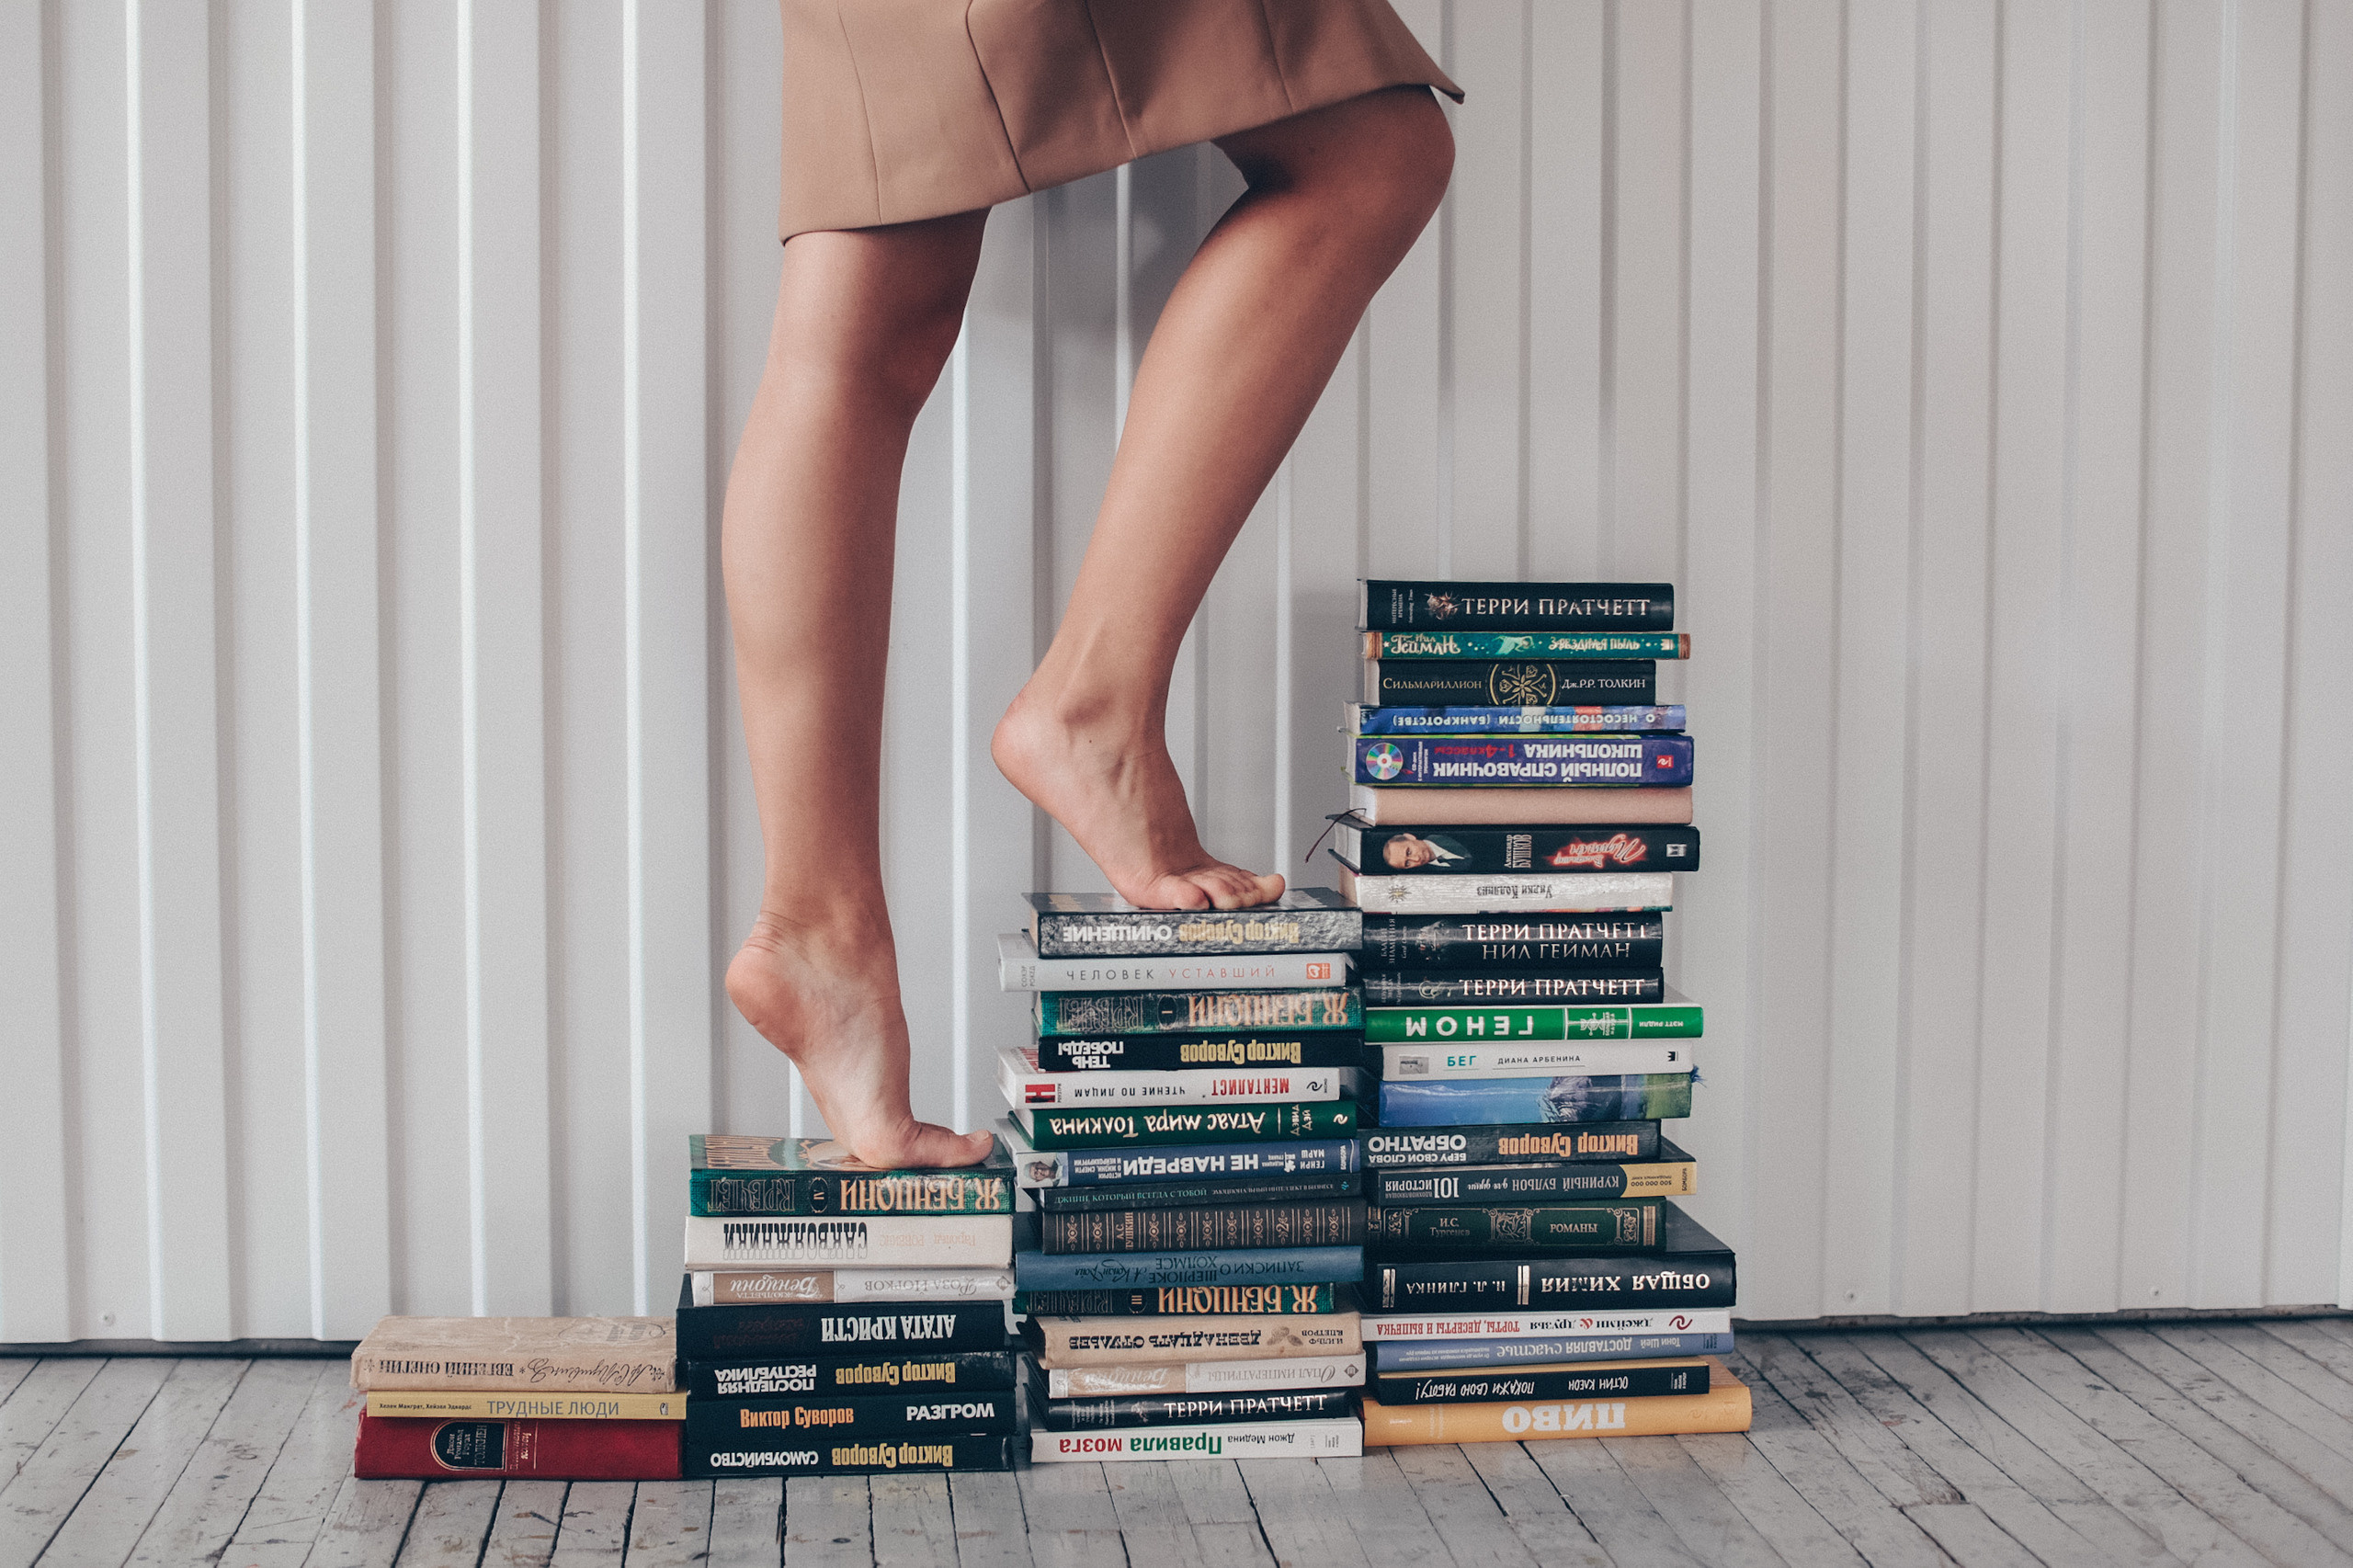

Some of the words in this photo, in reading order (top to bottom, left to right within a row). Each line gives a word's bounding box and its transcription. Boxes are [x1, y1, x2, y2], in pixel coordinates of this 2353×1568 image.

[1461, 597, 1529, 617] ТЕРРИ
[1539, 598, 1651, 617] ПРАТЧЕТТ
[1597, 677, 1646, 689] ТОЛКИН
[1392, 713, 1491, 727] (БАНКРОТСТВЕ)
[1499, 713, 1638, 725] НЕСОСТОЯТЕЛЬНОСТИ
[1645, 713, 1655, 724] О
[1525, 743, 1643, 758] ШКОЛЬНИКА
[1434, 762, 1557, 778] СПРАВОЧНИК
[1562, 762, 1643, 783] ПОЛНЫЙ
[1512, 834, 1533, 869] БУШКОВ
[1570, 834, 1646, 864] Путин
[1063, 923, 1173, 942] ОЧИЩЕНИЕ
[1178, 922, 1244, 945] Суворов
[1245, 920, 1300, 943] Виктор
[1462, 923, 1531, 941] ТЕРРИ
[1540, 921, 1650, 938] ПРАТЧЕТТ
[1482, 943, 1531, 960] НИЛ
[1540, 939, 1632, 959] ГЕЙМАН
[1066, 968, 1154, 981] ЧЕЛОВЕК
[1169, 963, 1276, 979] УСТАВШИЙ
[1459, 978, 1528, 996] ТЕРРИ
[1534, 977, 1646, 996] ПРАТЧЕТТ
[1188, 994, 1313, 1028] БЕНЦОНИ
[1405, 1015, 1535, 1038] ГЕНОМ
[1639, 1019, 1664, 1028] РИДЛИ
[1664, 1019, 1685, 1028] МЭТТ
[1058, 1040, 1123, 1055] ПОБЕДЫ
[1180, 1040, 1245, 1064] Суворов
[1245, 1041, 1302, 1063] Виктор
[1072, 1055, 1111, 1069] ТЕНЬ
[1447, 1054, 1477, 1067] БЕГ
[1497, 1056, 1529, 1065] ДИАНА
[1532, 1054, 1581, 1063] АРБЕНИНА
[1074, 1087, 1115, 1098] ЛИЦАМ
[1120, 1087, 1136, 1096] ПО
[1142, 1085, 1185, 1096] ЧТЕНИЕ
[1211, 1077, 1290, 1096] МЕНТАЛИСТ
[1048, 1115, 1139, 1139] Толкина
[1143, 1108, 1201, 1135] мира
[1207, 1110, 1267, 1136] Атлас
[1291, 1104, 1301, 1136] ДЭВИД
[1368, 1133, 1467, 1152] ОБРАТНО
[1498, 1131, 1572, 1156] Суворов
[1577, 1131, 1639, 1155] Виктор
[1301, 1148, 1324, 1158] МАРШ
[1369, 1153, 1407, 1164] СЛОВА
[1444, 1152, 1467, 1162] БЕРУ
[1122, 1155, 1225, 1176] НАВРЕДИ
[1230, 1153, 1259, 1172] НЕ
[1299, 1160, 1324, 1170] ГЕНРИ
[1384, 1178, 1433, 1192] ИСТОРИЯ
[1433, 1177, 1461, 1199] 101
[1467, 1177, 1491, 1191] души
[1511, 1177, 1557, 1191] БУЛЬОН
[1562, 1175, 1620, 1191] КУРИНЫЙ
[840, 1176, 966, 1211] БЕНЦОНИ
[1176, 1187, 1208, 1198] ТОБОЙ
[1439, 1217, 1460, 1228] И.С.
[1550, 1222, 1598, 1233] РОМАНЫ
[723, 1221, 868, 1260] САКВОЯЖНИКИ
[1155, 1256, 1218, 1269] ХОЛМСЕ
[1219, 1264, 1232, 1276] О
[1233, 1260, 1304, 1276] ЗАПИСКИ
[1148, 1268, 1218, 1284] ШЕРЛОКЕ
[1541, 1275, 1620, 1293] ХИМИЯ
[1631, 1270, 1711, 1290] ОБЩАЯ
[864, 1279, 929, 1296] ЙОРКОВ
[1406, 1281, 1468, 1295] ГЛИНКА
[1157, 1286, 1282, 1314] БЕНЦОНИ
[1284, 1285, 1320, 1314] Ж.
[821, 1315, 898, 1342] КРИСТИ
[899, 1314, 957, 1341] АГАТА
[1376, 1322, 1424, 1335] ВЫПЕЧКА
[1436, 1320, 1482, 1335] ДЕСЕРТЫ
[1484, 1319, 1520, 1334] ТОРТЫ,
[1068, 1334, 1145, 1351] СТУЛЬЕВ
[1148, 1329, 1262, 1349] ДВЕНАДЦАТЬ
[1564, 1335, 1632, 1354] ДОСТАВЛЯЯ
[1639, 1338, 1659, 1349] Шей
[1660, 1336, 1681, 1348] Тони
[1496, 1340, 1563, 1359] счастье
[378, 1358, 441, 1374] ОНЕГИН
[445, 1360, 515, 1380] ЕВГЕНИЙ
[713, 1363, 817, 1381] РЕСПУБЛИКА
[835, 1363, 900, 1386] Суворов
[903, 1361, 956, 1384] Виктор
[1207, 1367, 1297, 1381] ИМПЕРАТРИЦЫ
[717, 1378, 815, 1395] ПОСЛЕДНЯЯ
[1415, 1380, 1457, 1401] РАБОТУ!
[1459, 1381, 1488, 1397] СВОЮ
[1491, 1379, 1535, 1396] ПОКАЖИ
[1567, 1378, 1596, 1391] КЛЕОН
[1597, 1376, 1629, 1391] ОСТИН
[486, 1400, 564, 1416] ТРУДНЫЕ
[567, 1401, 620, 1417] ЛЮДИ
[905, 1402, 995, 1422] РАЗГРОМ
[1164, 1400, 1223, 1418] ТЕРРИ
[1230, 1392, 1328, 1414] ПРАТЧЕТТ
[740, 1407, 790, 1430] Виктор
[794, 1405, 855, 1429] Суворов
[1502, 1402, 1627, 1434] ПИВО
[1059, 1435, 1123, 1453] мозга
[1130, 1431, 1222, 1455] Правила
[1226, 1434, 1267, 1447] Медина
[1267, 1432, 1295, 1447] Джон
[710, 1449, 819, 1468] САМОУБИЙСТВО
[831, 1441, 898, 1469] Суворов
[898, 1442, 954, 1468] Виктор
